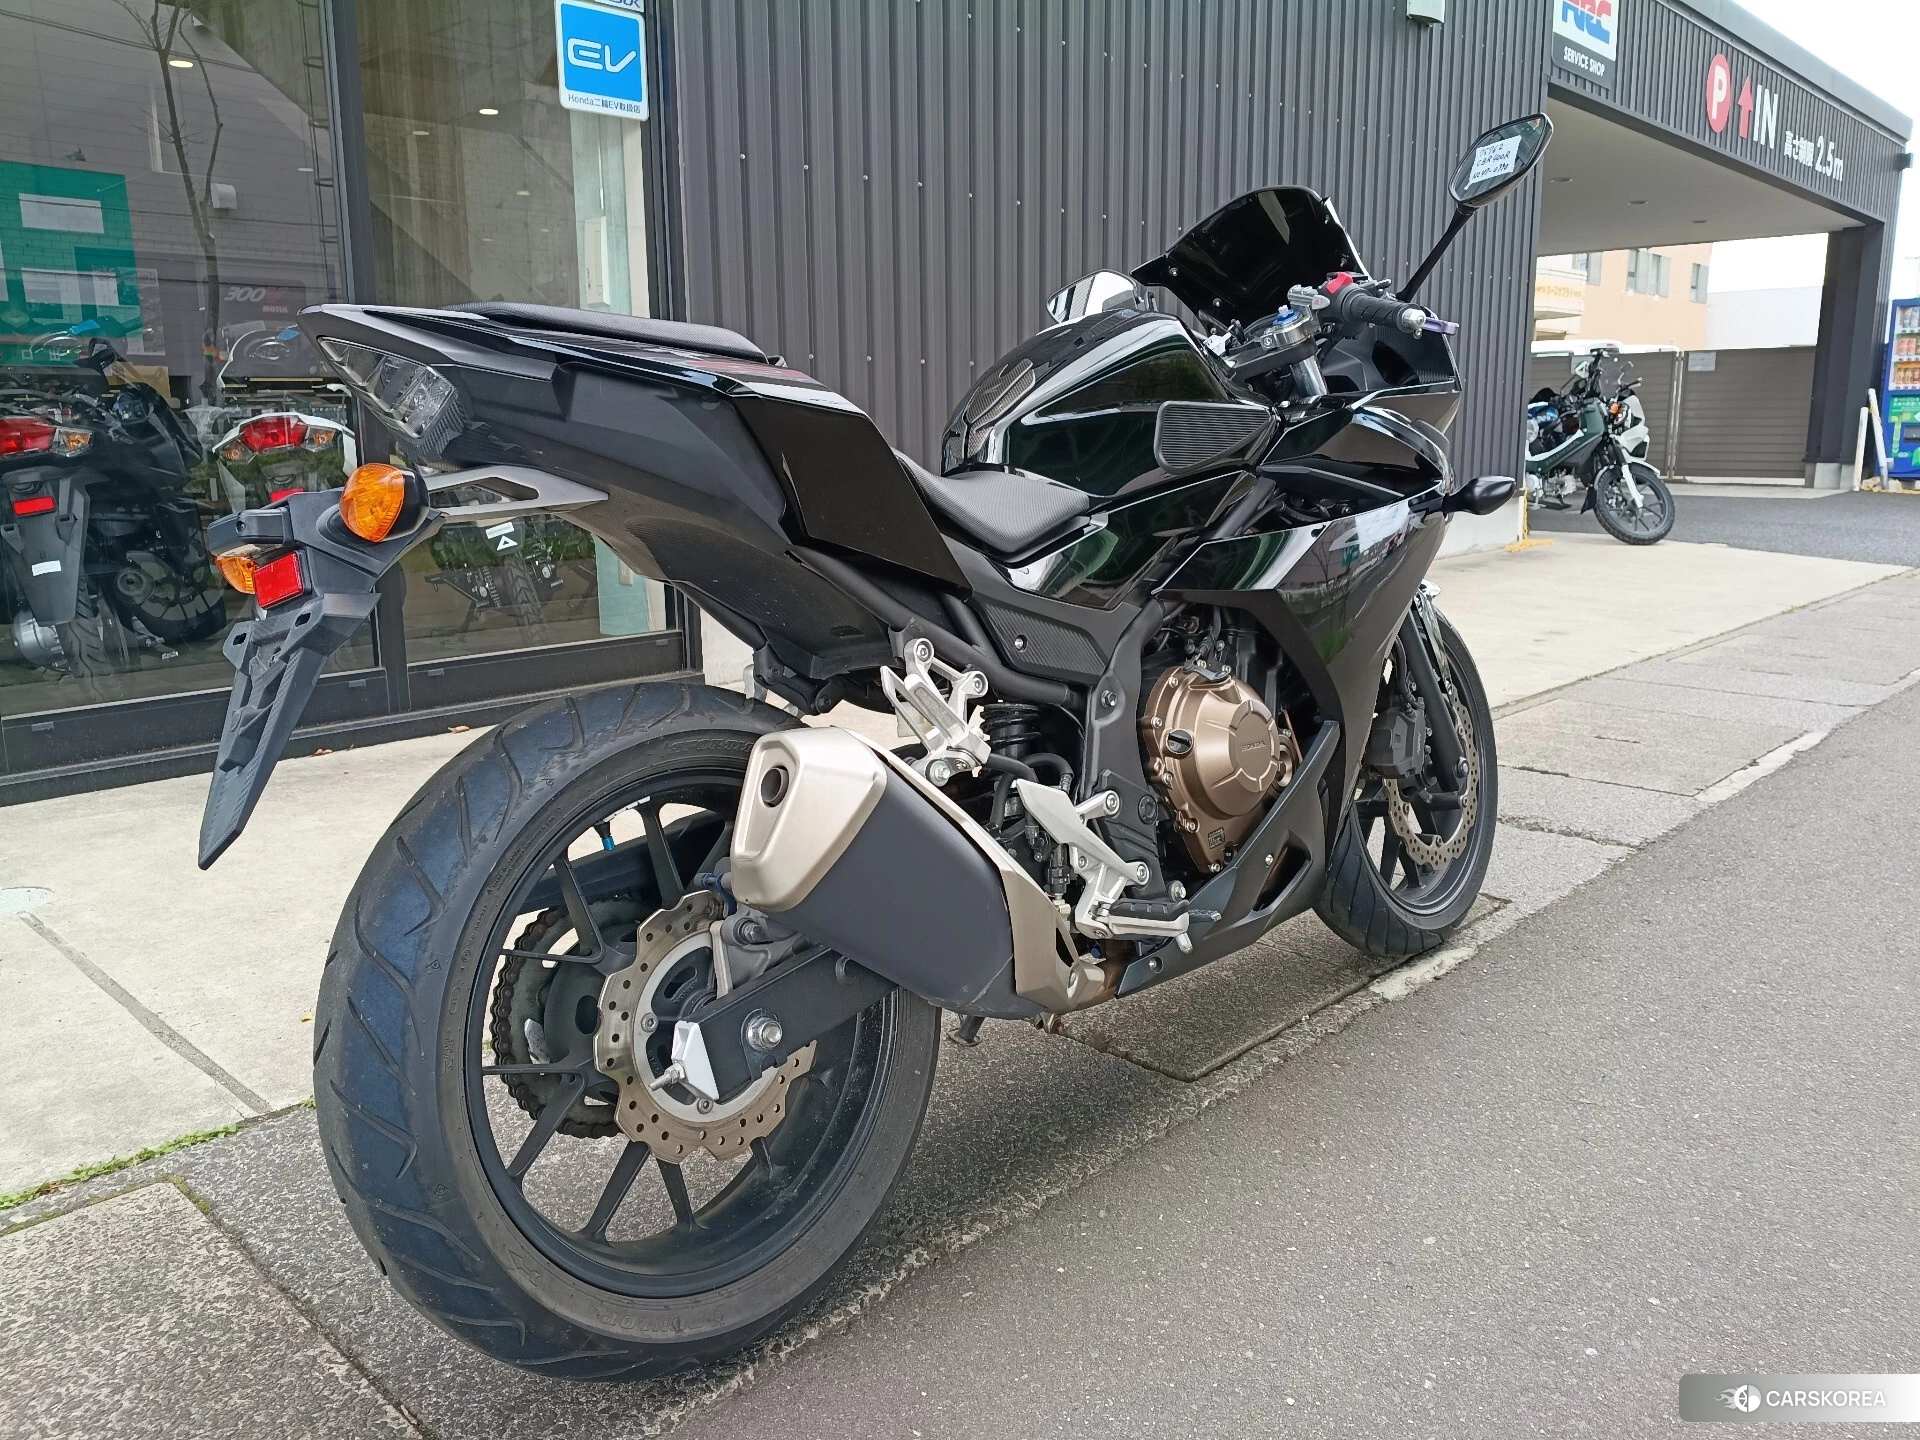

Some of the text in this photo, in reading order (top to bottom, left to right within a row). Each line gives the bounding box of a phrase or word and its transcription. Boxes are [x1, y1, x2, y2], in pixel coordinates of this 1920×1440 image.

[567, 37, 637, 73] EV
[1563, 45, 1605, 77] SERVICE SHOP
[1711, 64, 1778, 150] P IN
[1815, 135, 1844, 182] 2.5m
[262, 304, 289, 314] MOTUL
